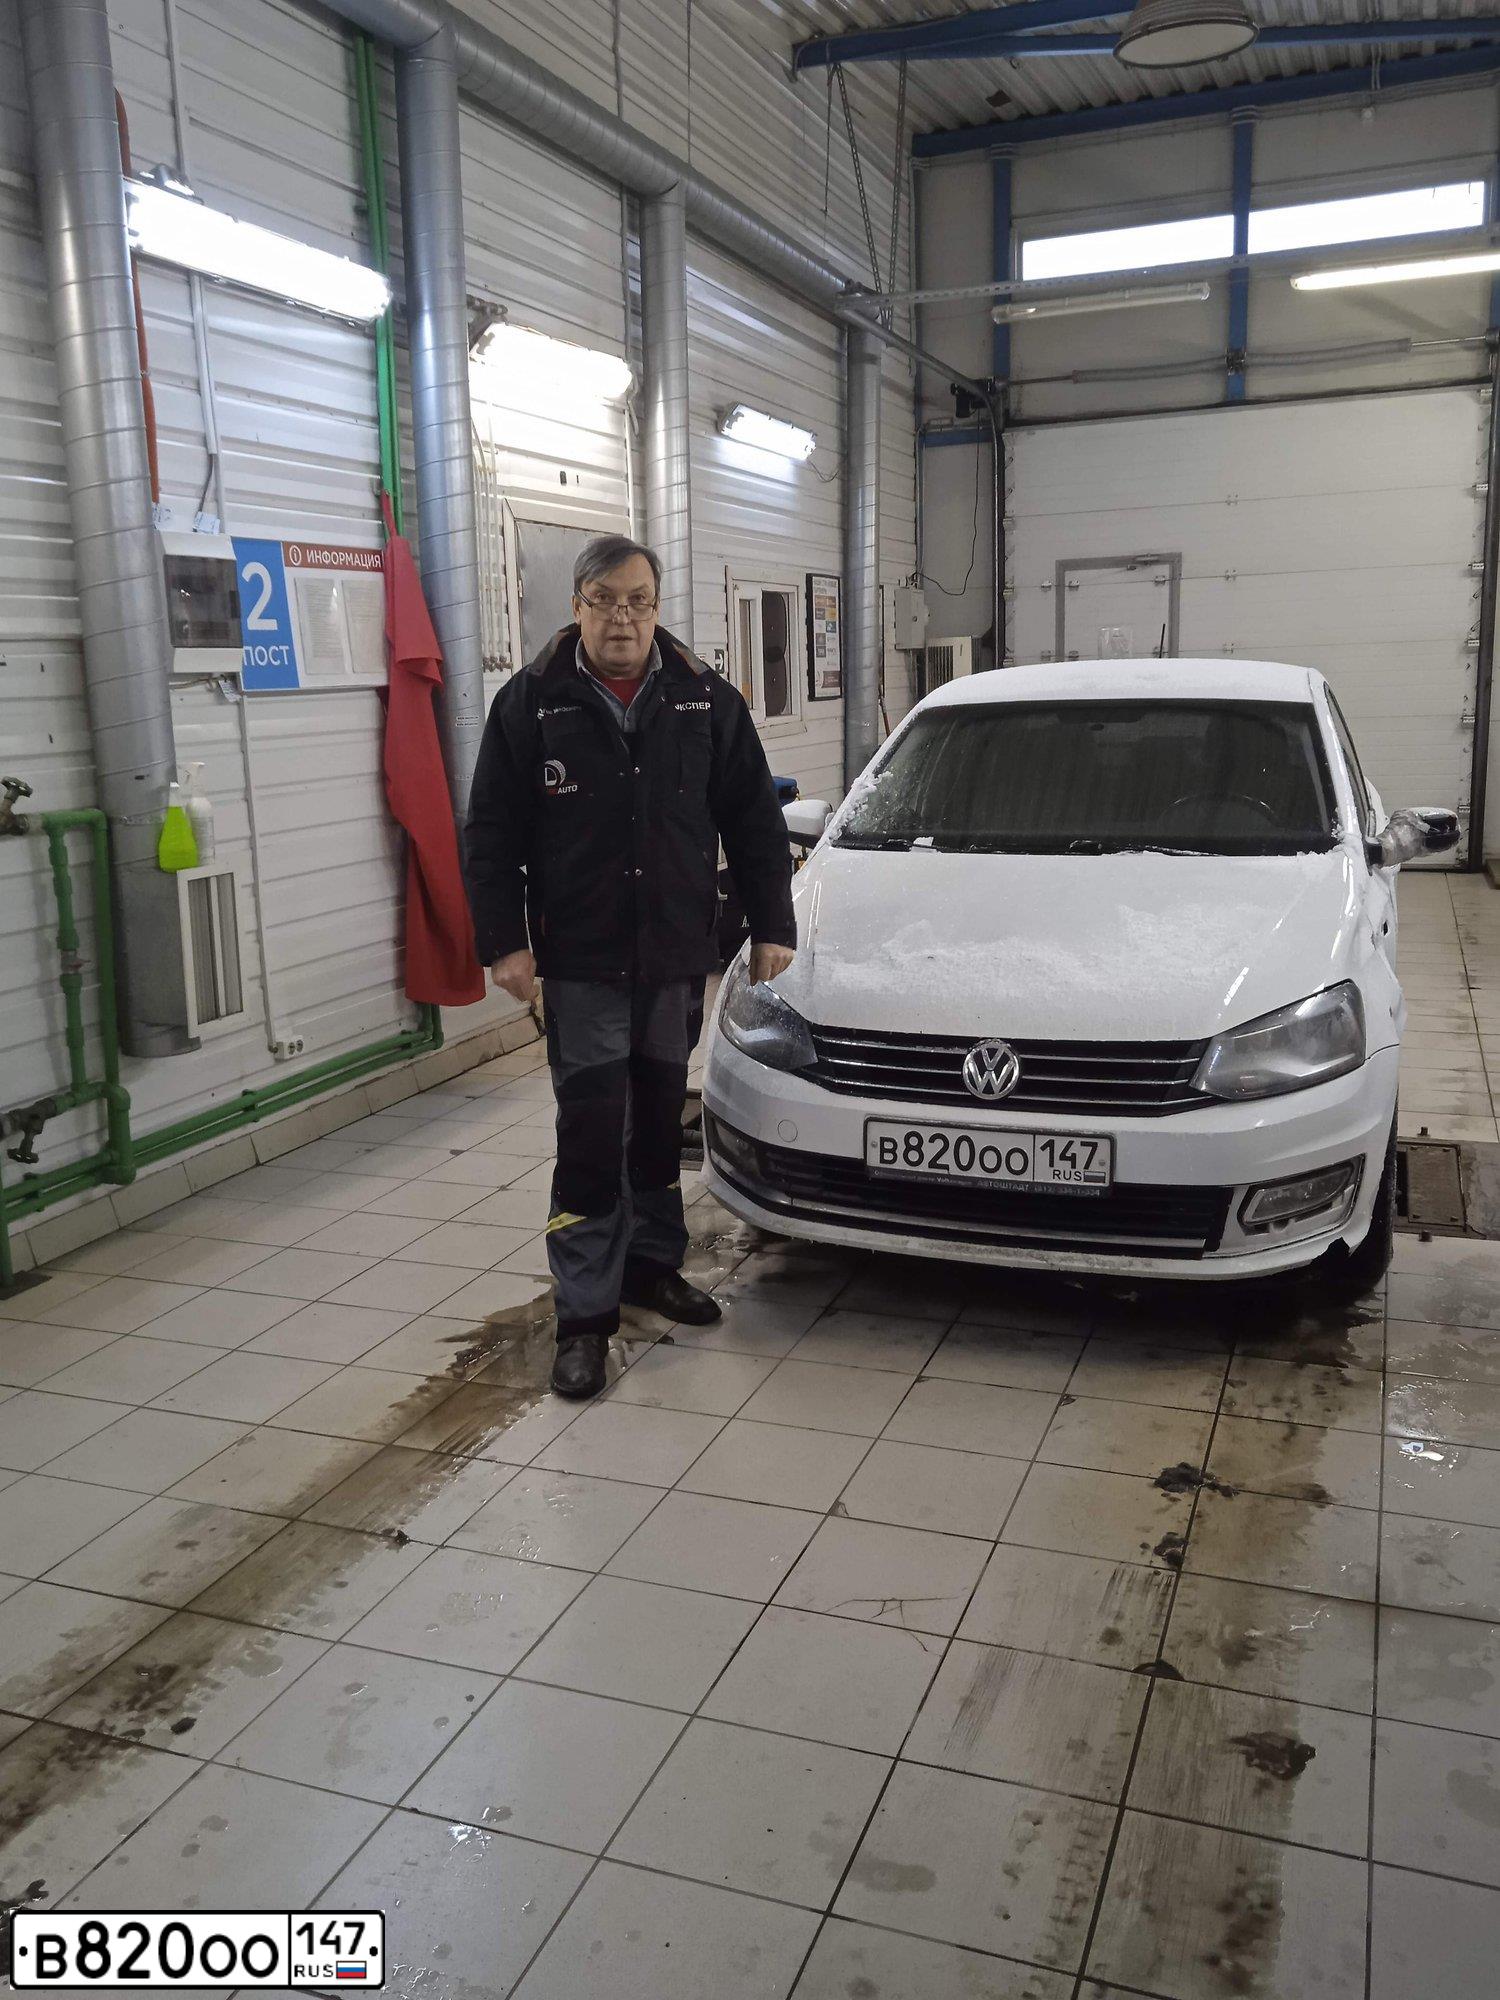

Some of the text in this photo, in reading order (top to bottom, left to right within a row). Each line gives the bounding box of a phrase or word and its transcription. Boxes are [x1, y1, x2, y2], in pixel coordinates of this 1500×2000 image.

[306, 550, 382, 568] ИНФОРМАЦИЯ
[242, 562, 277, 630] 2
[243, 645, 290, 666] ПОСТ
[879, 1130, 1029, 1176] В820ОО
[1039, 1139, 1099, 1169] 147
[1052, 1169, 1082, 1182] RUS
